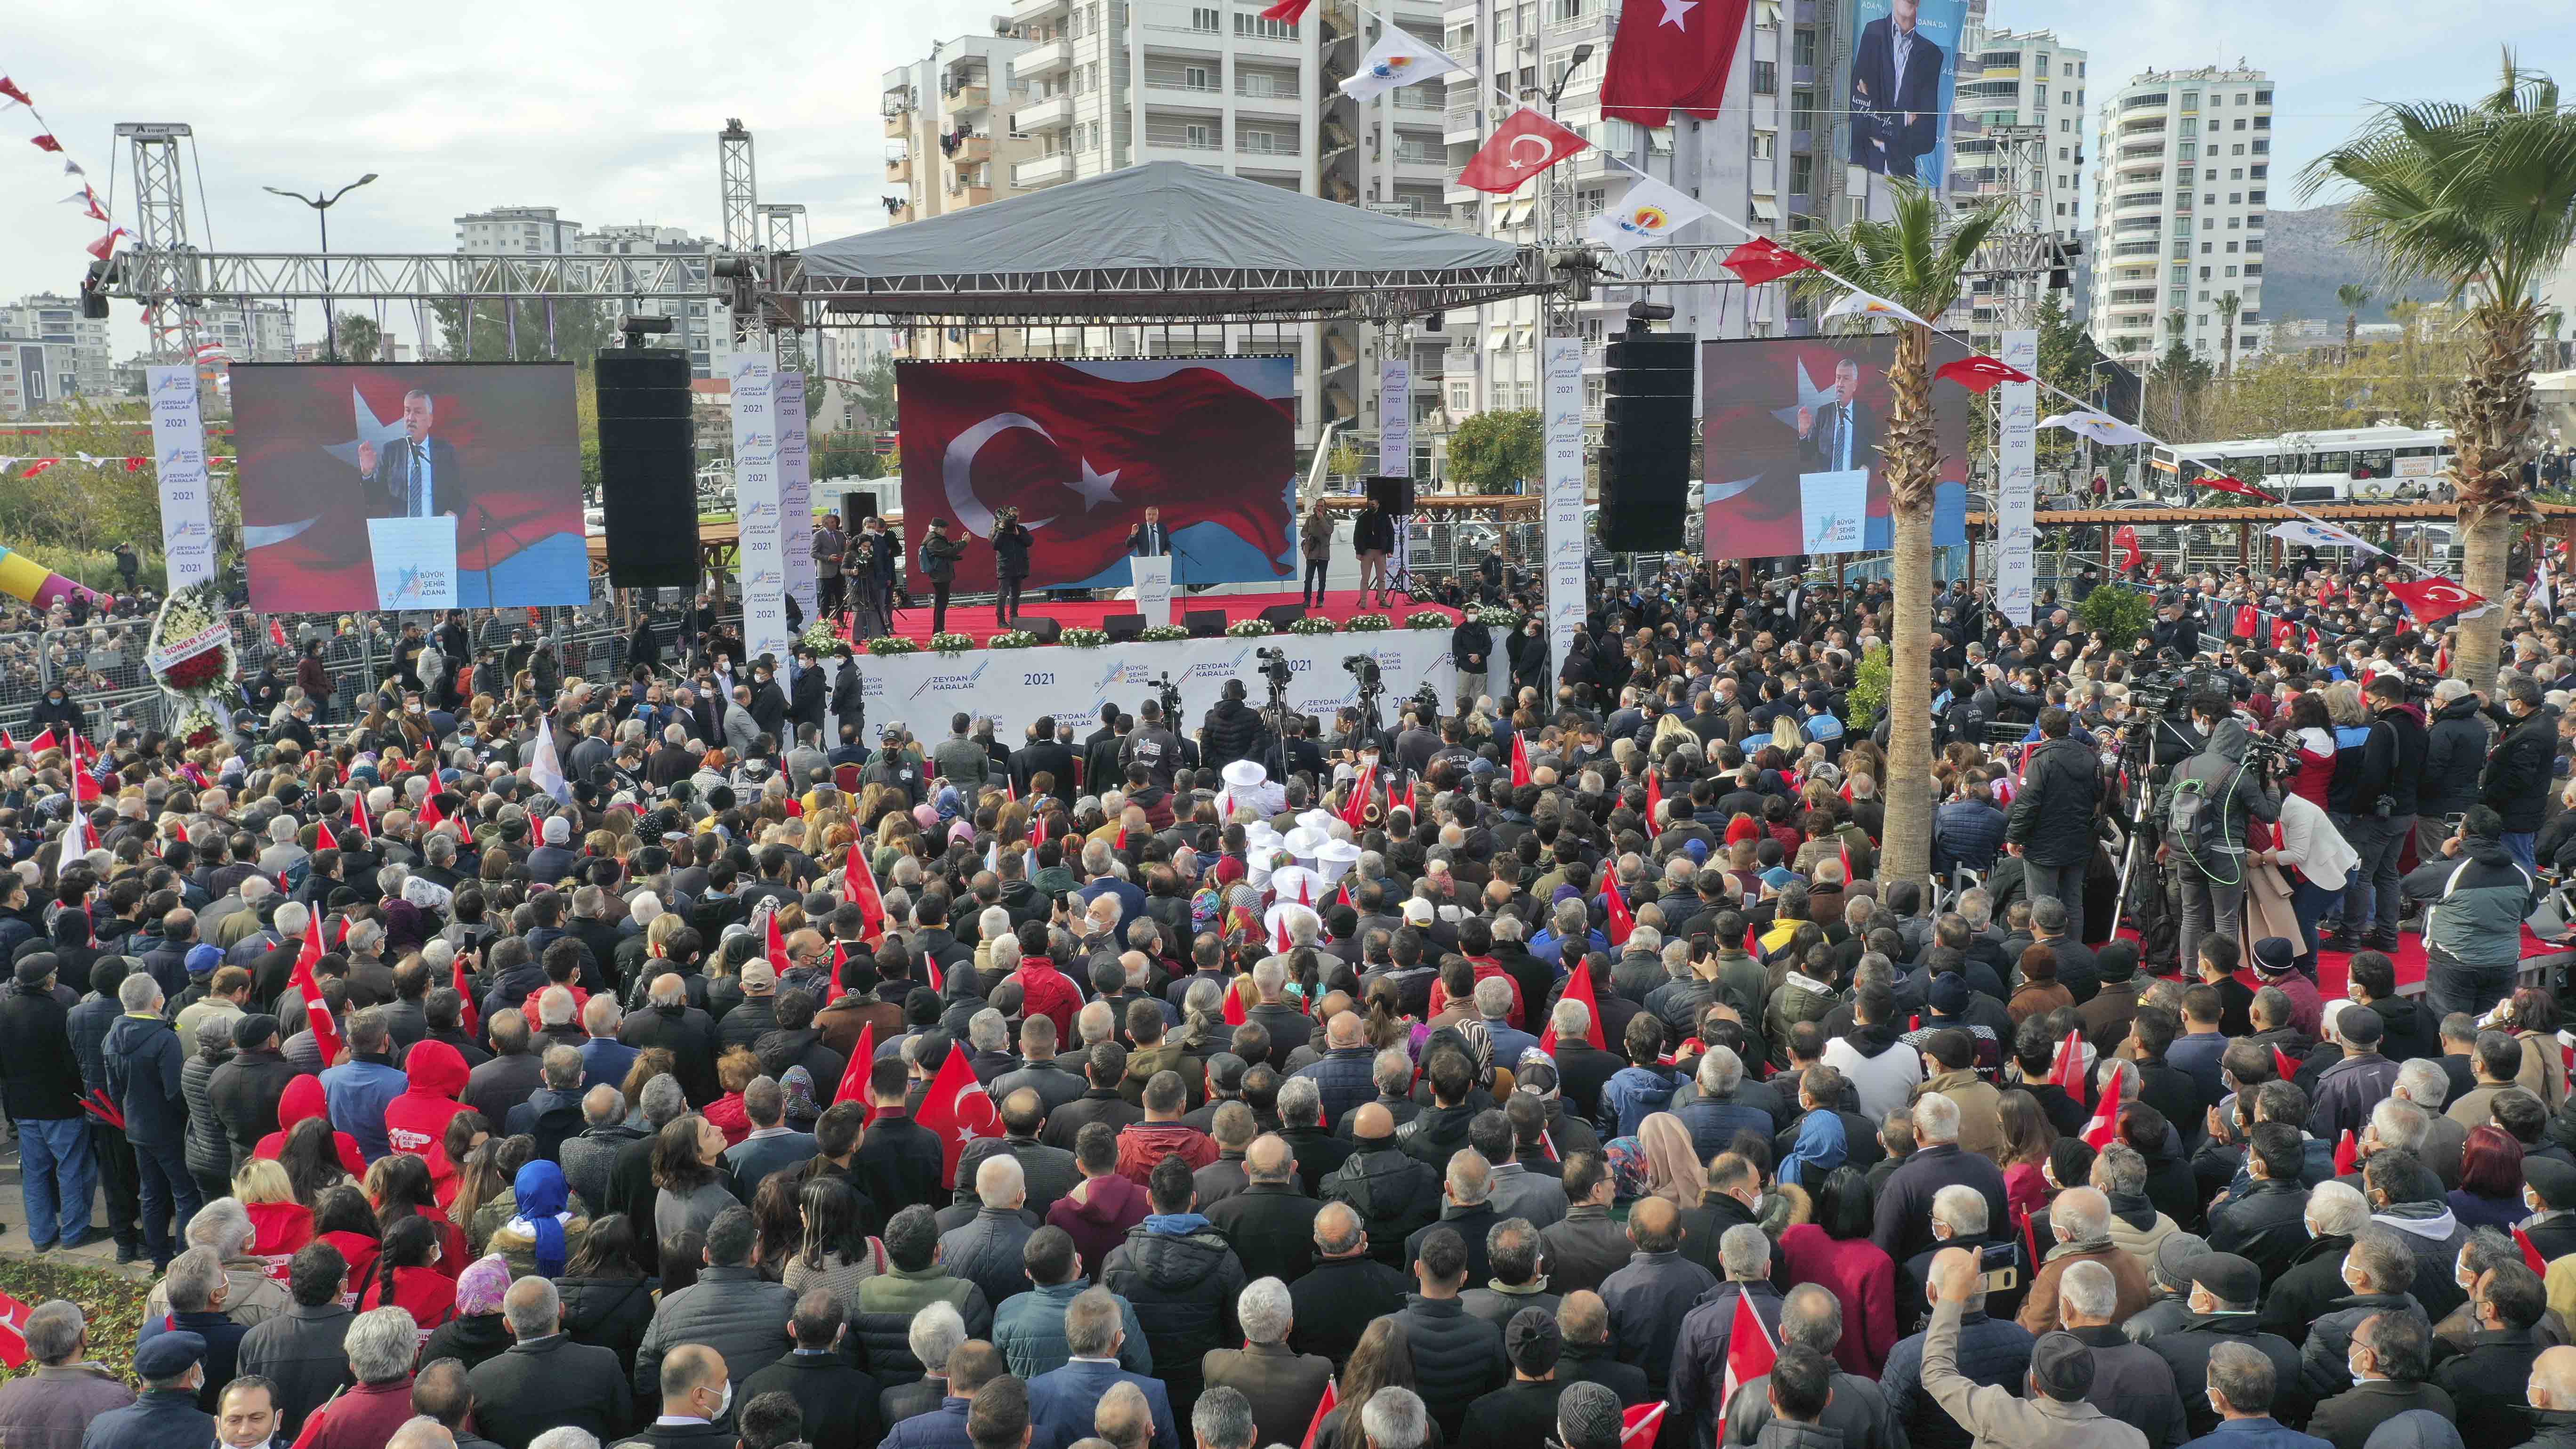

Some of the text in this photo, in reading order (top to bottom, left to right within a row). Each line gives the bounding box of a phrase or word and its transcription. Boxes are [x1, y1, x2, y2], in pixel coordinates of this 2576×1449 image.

[1917, 18, 1947, 29] DANA'DA
[743, 404, 763, 412] 2021
[165, 418, 187, 428] 2021
[1582, 431, 1604, 447] ptik
[748, 474, 767, 482] 2021
[173, 492, 194, 500] 2021
[1839, 527, 1856, 535] ŞEHİR
[752, 542, 772, 550] 2021
[180, 564, 201, 572] 2021
[2009, 561, 2025, 569] 2021
[424, 580, 445, 589] ŞEHİR
[1561, 577, 1577, 585] 2021
[757, 610, 775, 618] 2021
[165, 623, 226, 655] SONER ÇETİN
[1024, 673, 1055, 686] 2021
